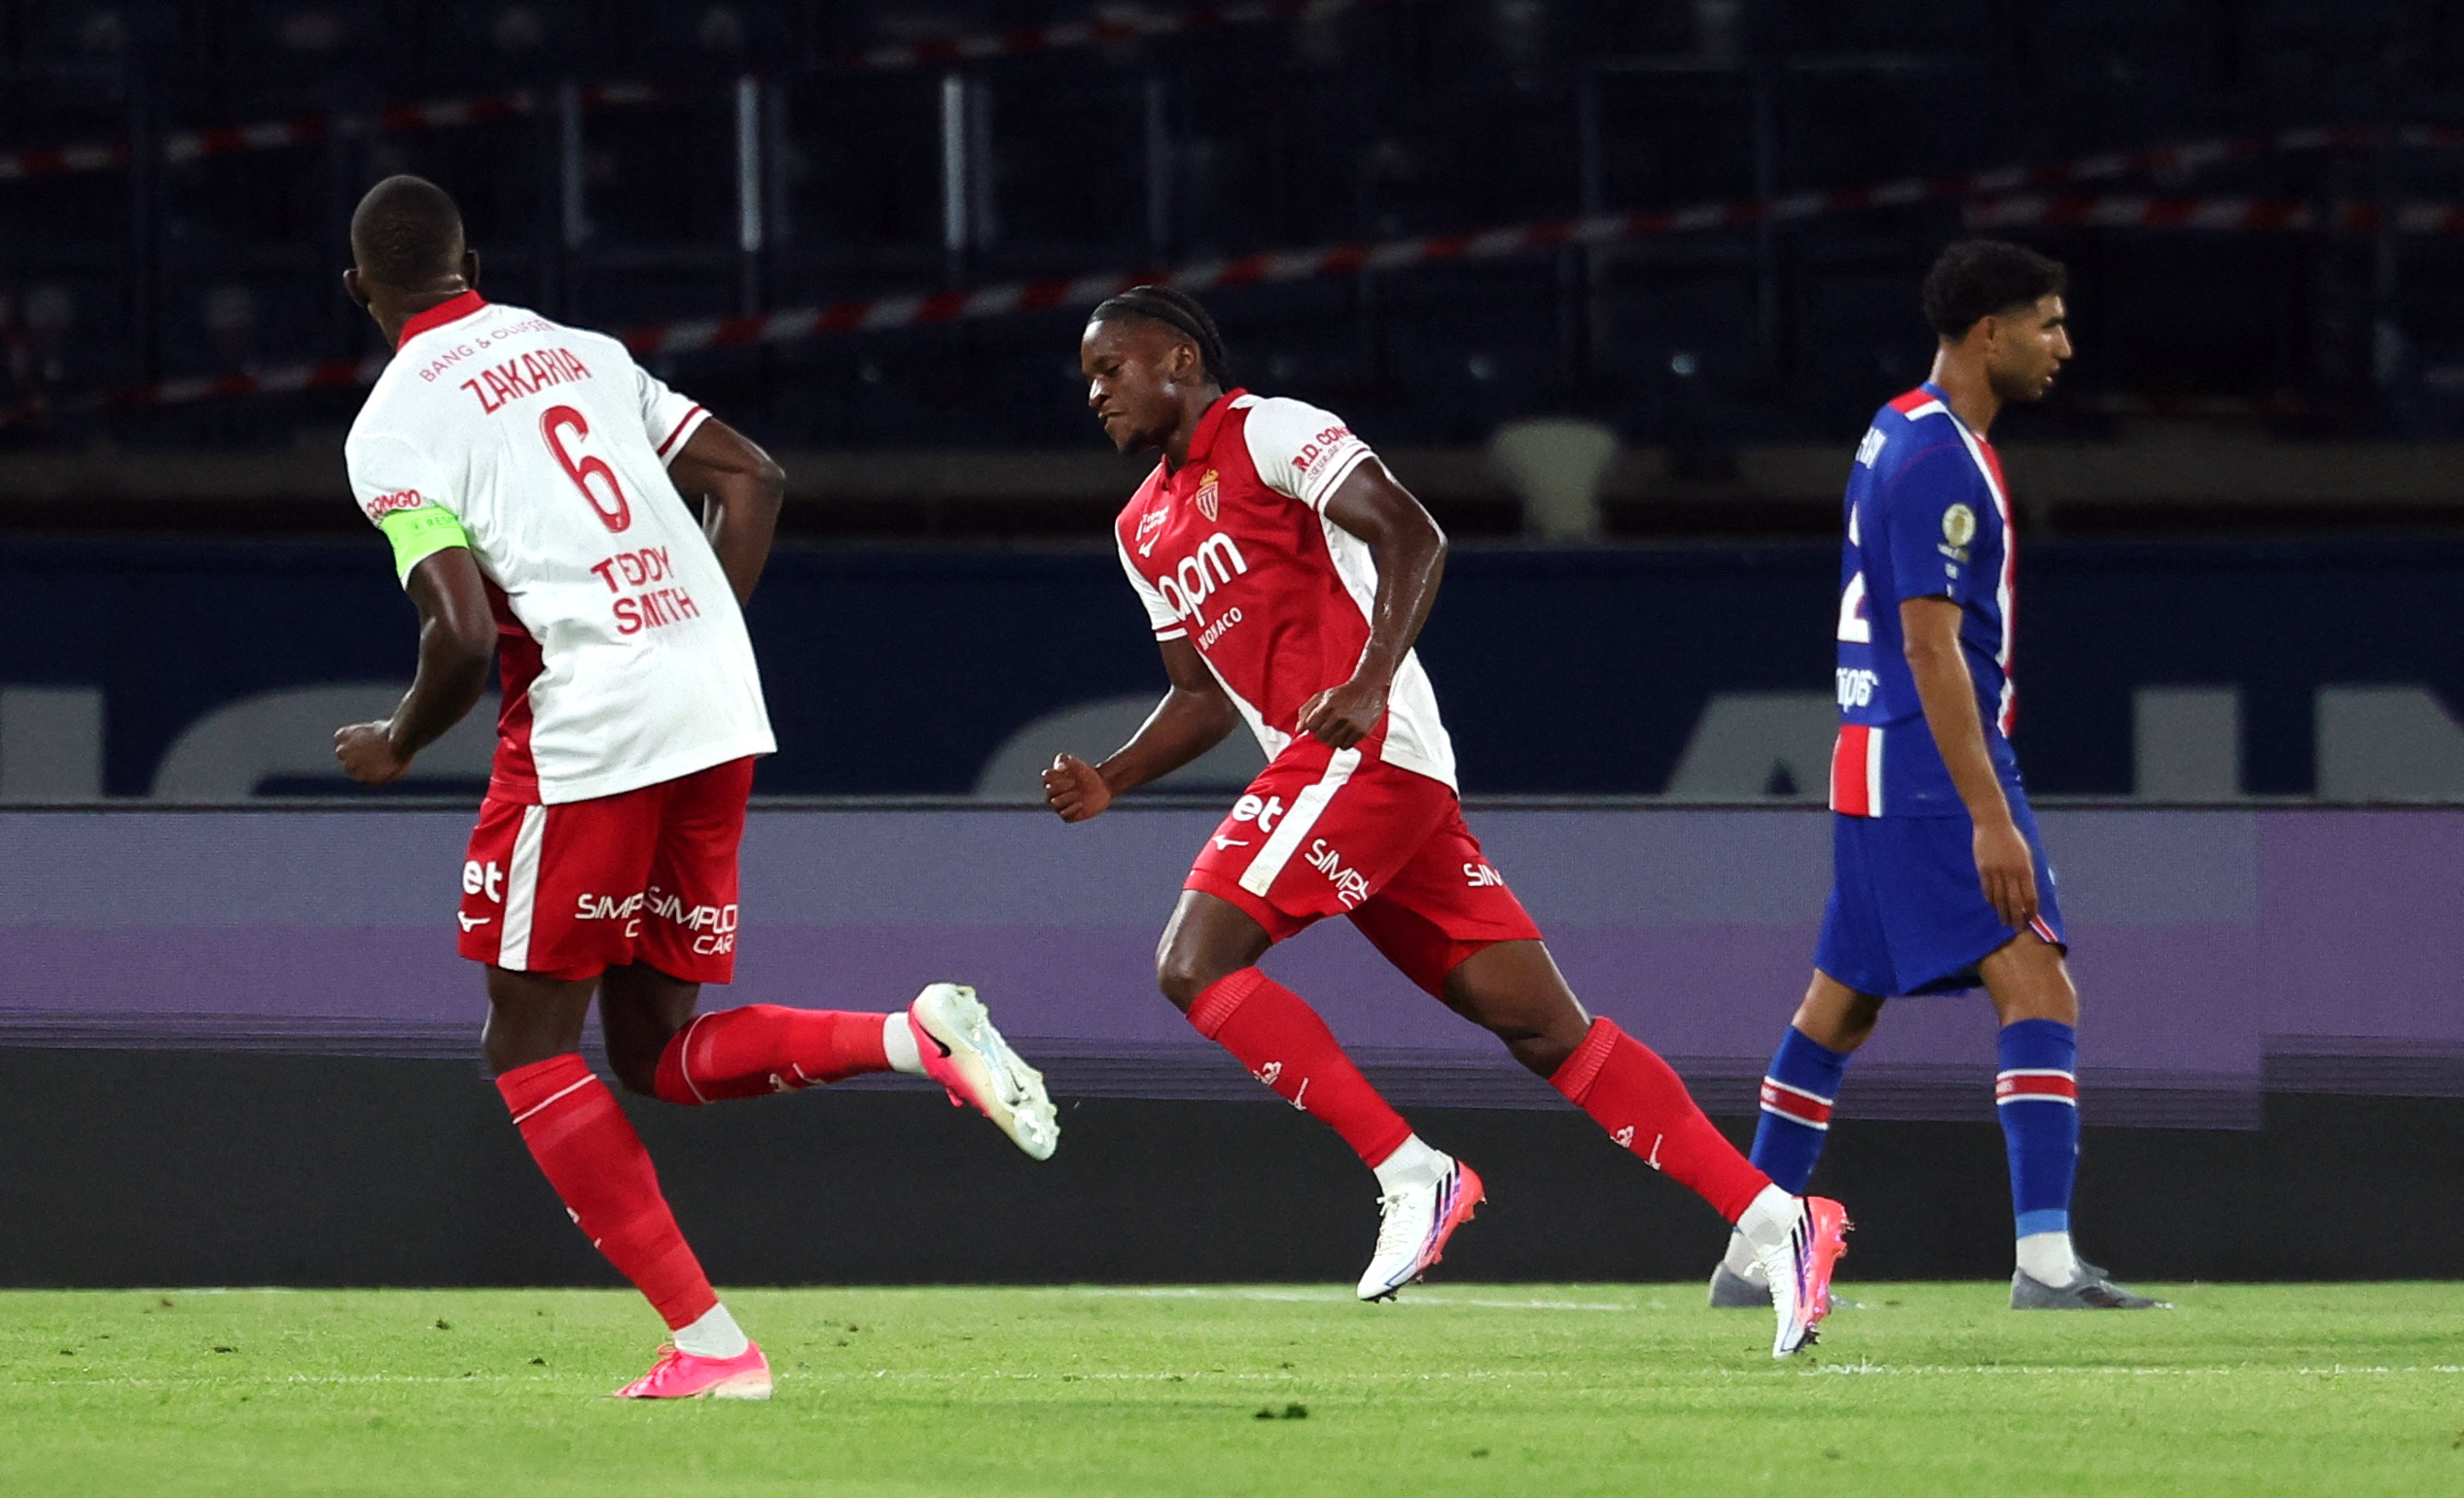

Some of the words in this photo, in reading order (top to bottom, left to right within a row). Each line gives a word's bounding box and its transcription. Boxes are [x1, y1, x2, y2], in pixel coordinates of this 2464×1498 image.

[418, 344, 475, 382] BANG
[475, 338, 491, 349] &
[459, 347, 592, 414] ZAKARIA
[539, 405, 631, 533] 6
[1159, 532, 1248, 628] apm
